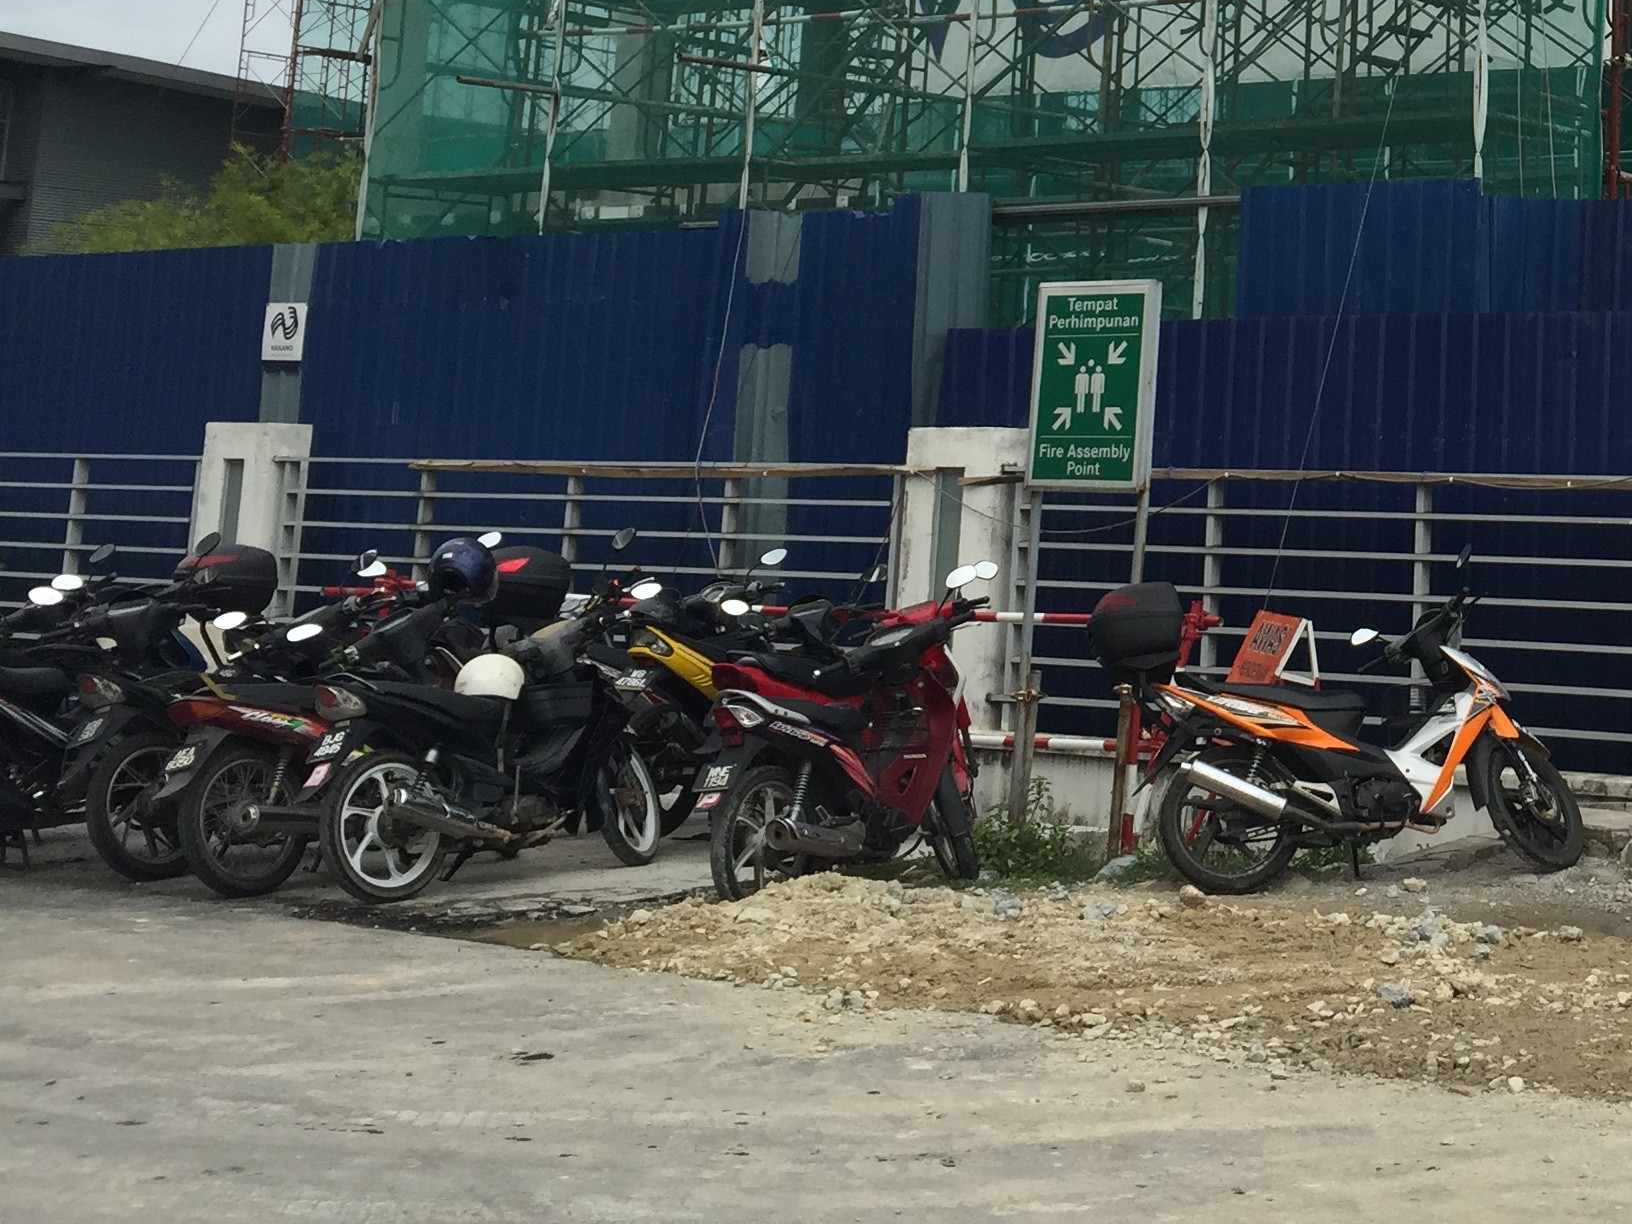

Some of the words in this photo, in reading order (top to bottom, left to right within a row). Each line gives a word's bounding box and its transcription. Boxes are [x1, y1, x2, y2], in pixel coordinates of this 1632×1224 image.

[1067, 297, 1119, 313] Tempat
[1050, 314, 1139, 332] Perhimpunan
[1039, 443, 1065, 458] Fire
[1067, 443, 1131, 461] Assembly
[1066, 461, 1100, 476] Point
